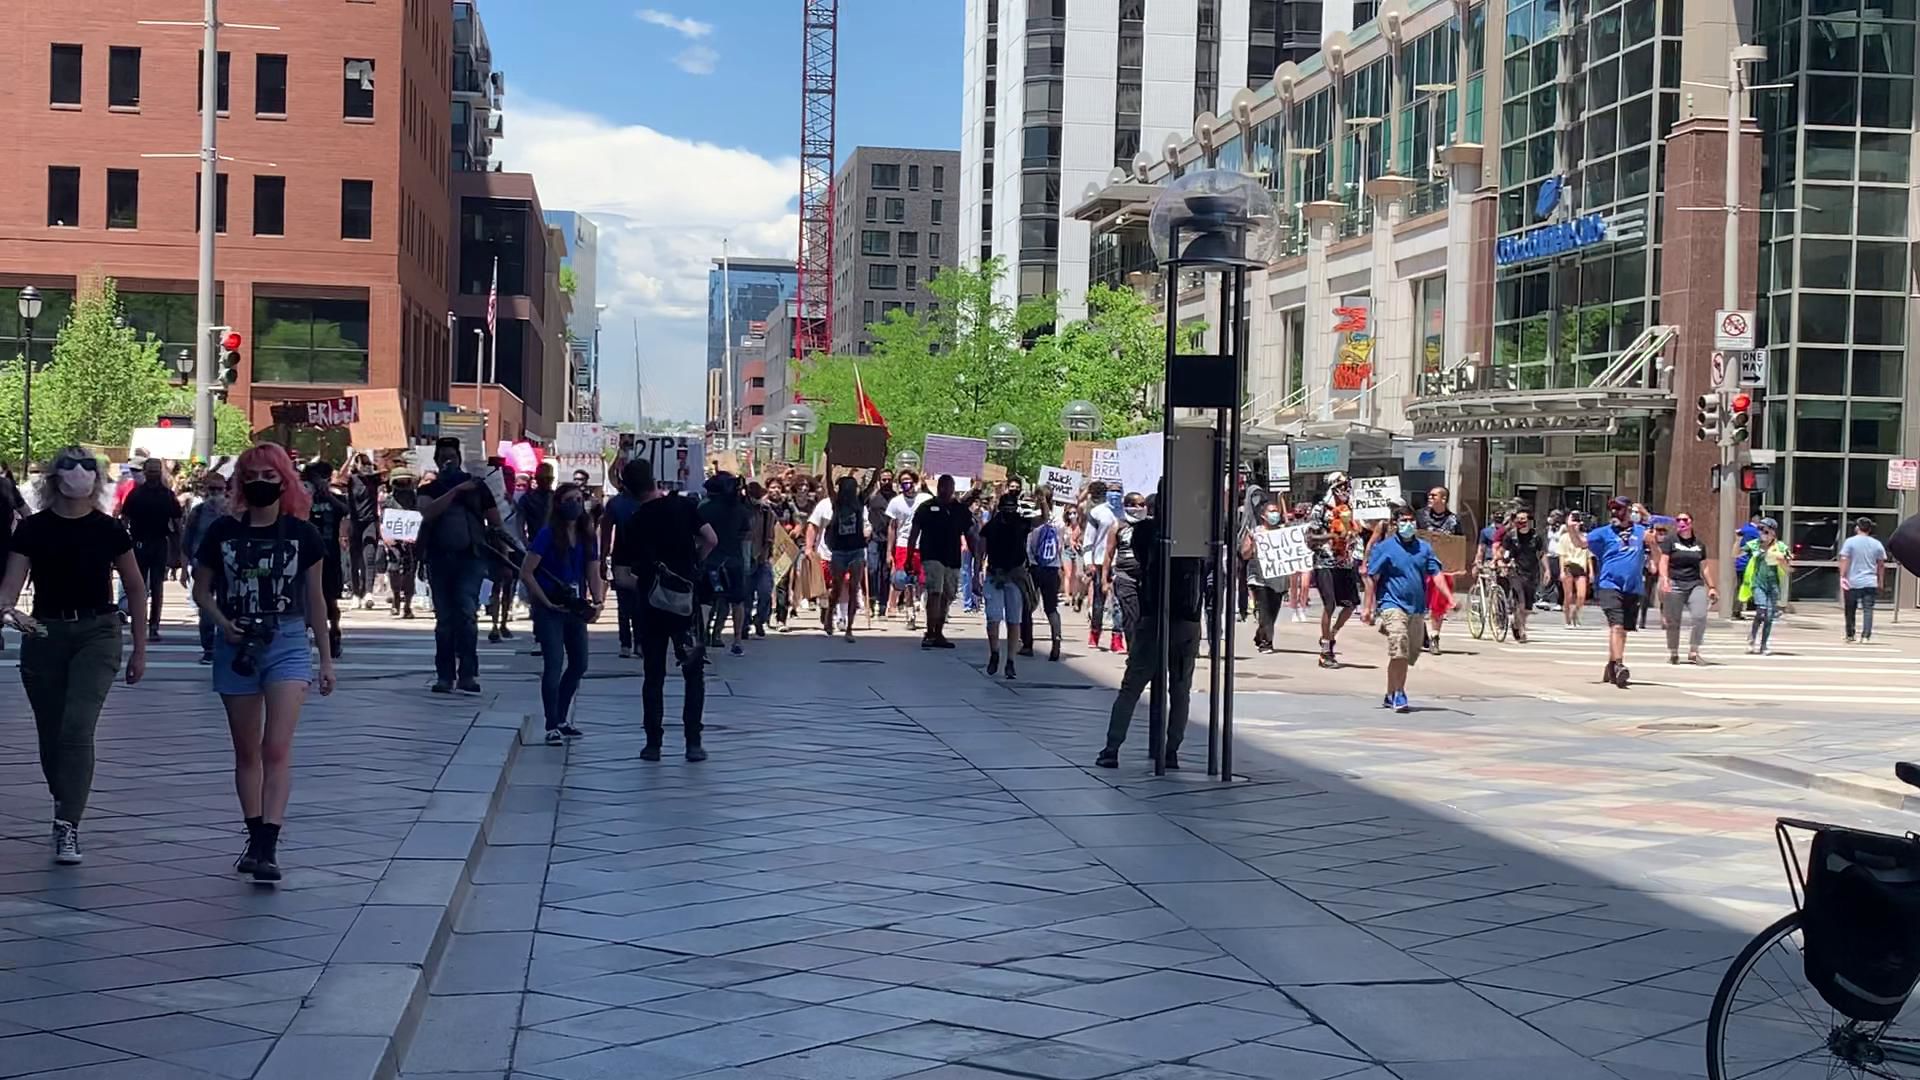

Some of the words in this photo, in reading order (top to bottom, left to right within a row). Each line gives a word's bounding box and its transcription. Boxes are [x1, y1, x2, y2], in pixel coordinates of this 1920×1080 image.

[1742, 352, 1763, 362] ONE
[1742, 363, 1763, 372] WAY
[1361, 479, 1387, 489] FUCK
[1365, 489, 1382, 498] THE
